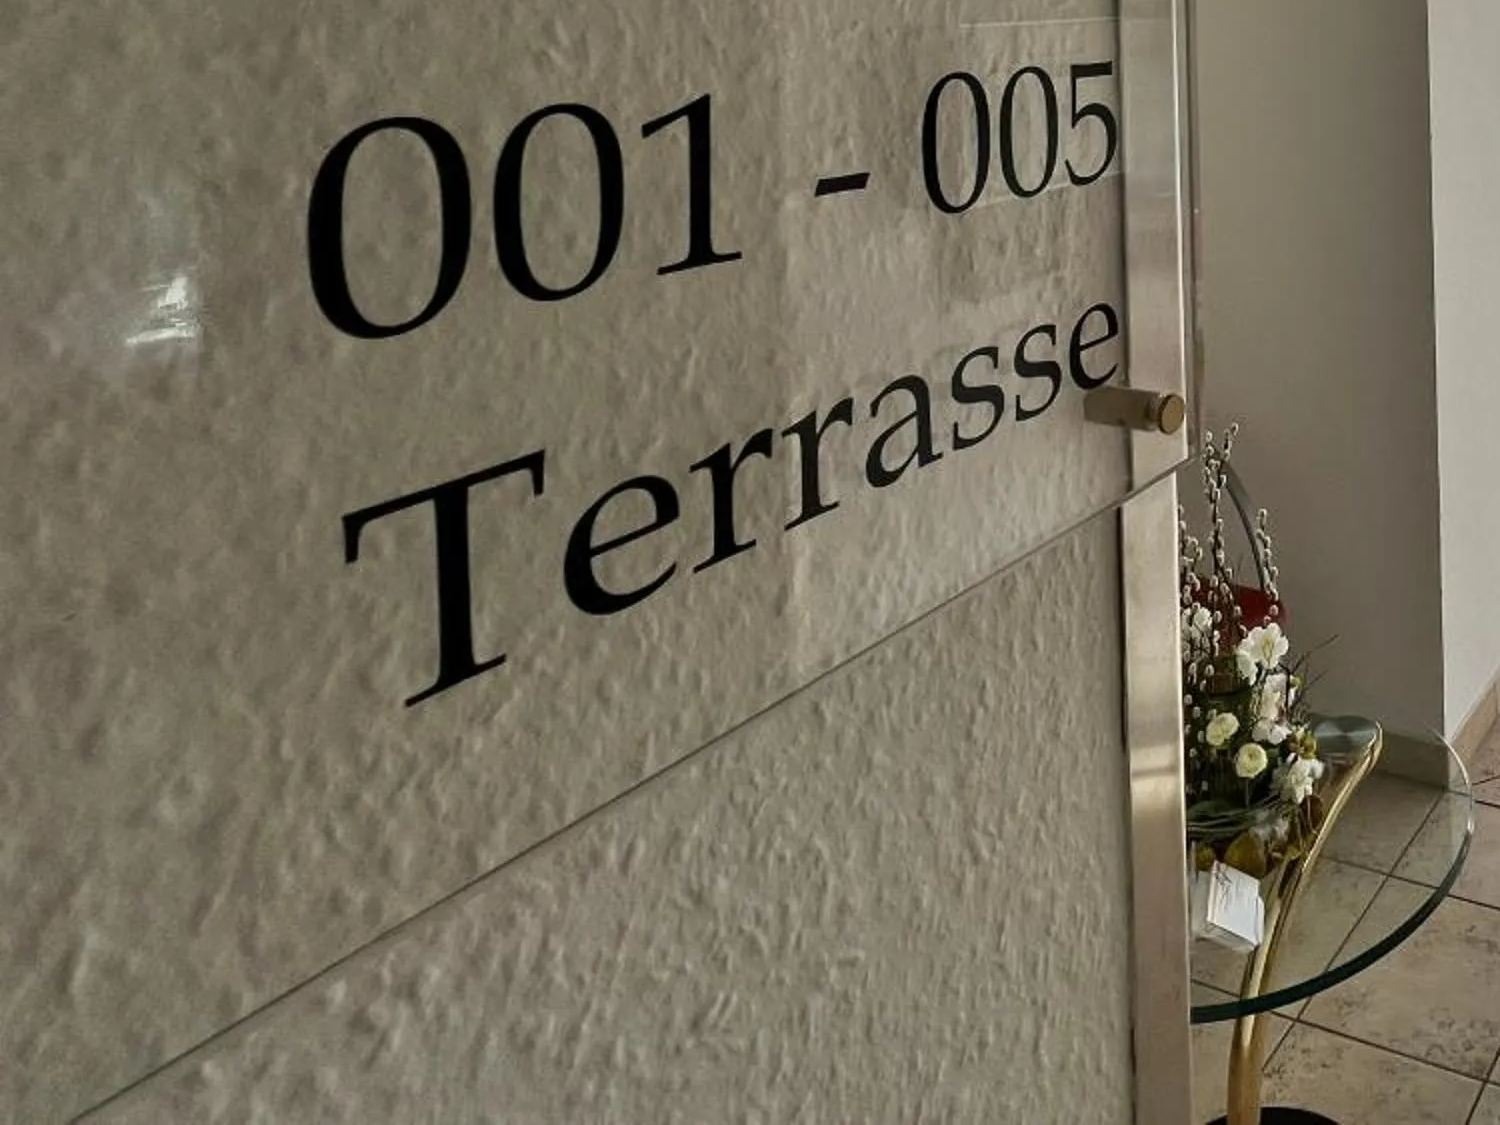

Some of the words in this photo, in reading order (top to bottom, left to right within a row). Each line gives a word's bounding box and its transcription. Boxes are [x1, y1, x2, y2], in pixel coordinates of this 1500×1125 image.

[307, 93, 742, 339] 001
[814, 172, 870, 197] -
[922, 61, 1117, 213] 005
[342, 302, 1120, 708] Terrasse
